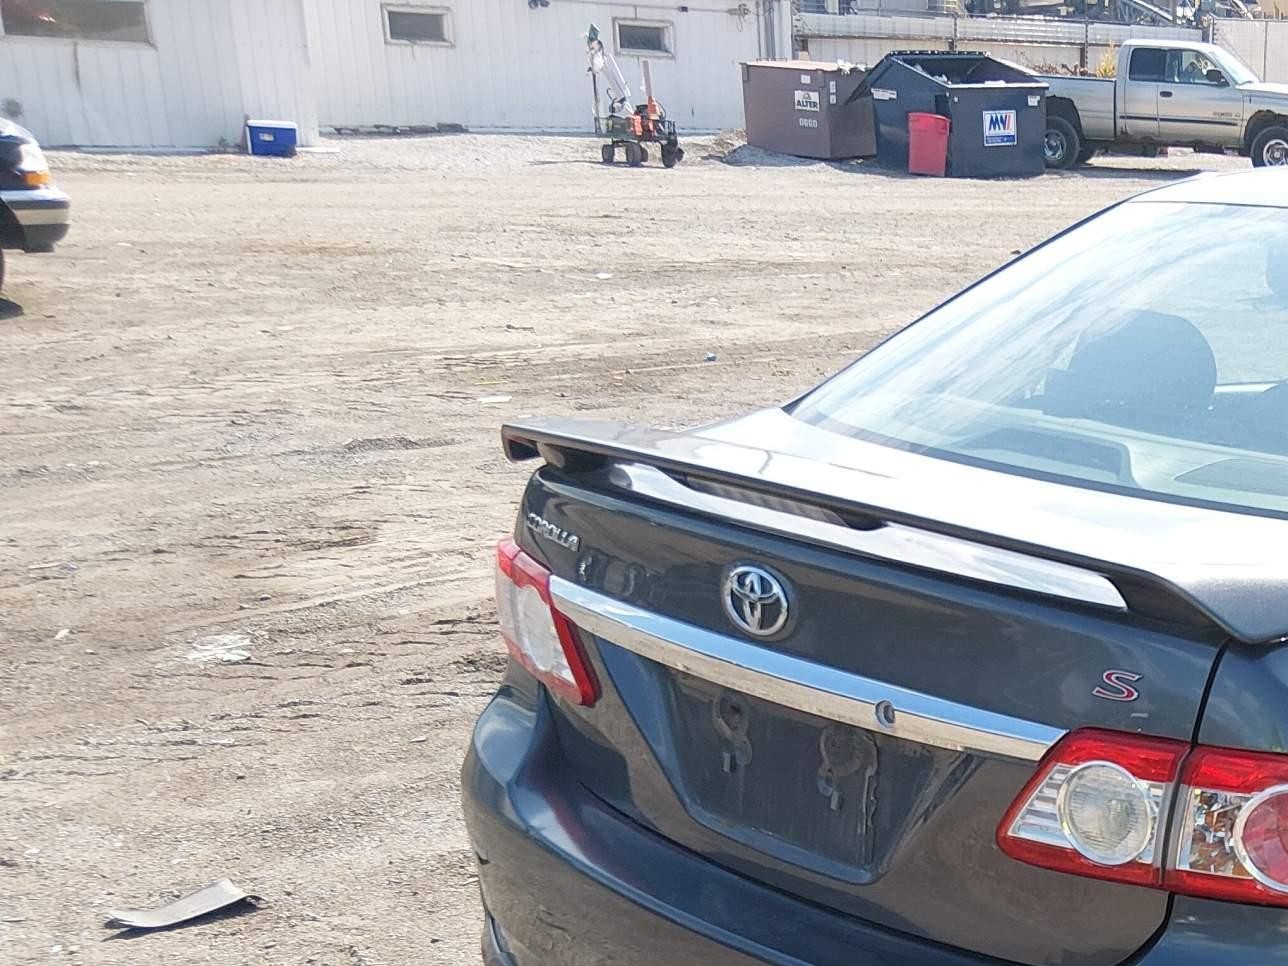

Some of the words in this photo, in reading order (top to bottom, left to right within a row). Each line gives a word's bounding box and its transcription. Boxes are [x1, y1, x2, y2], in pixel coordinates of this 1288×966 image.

[796, 100, 818, 109] ALTER
[527, 512, 580, 552] COROLLA
[1091, 669, 1143, 701] S
